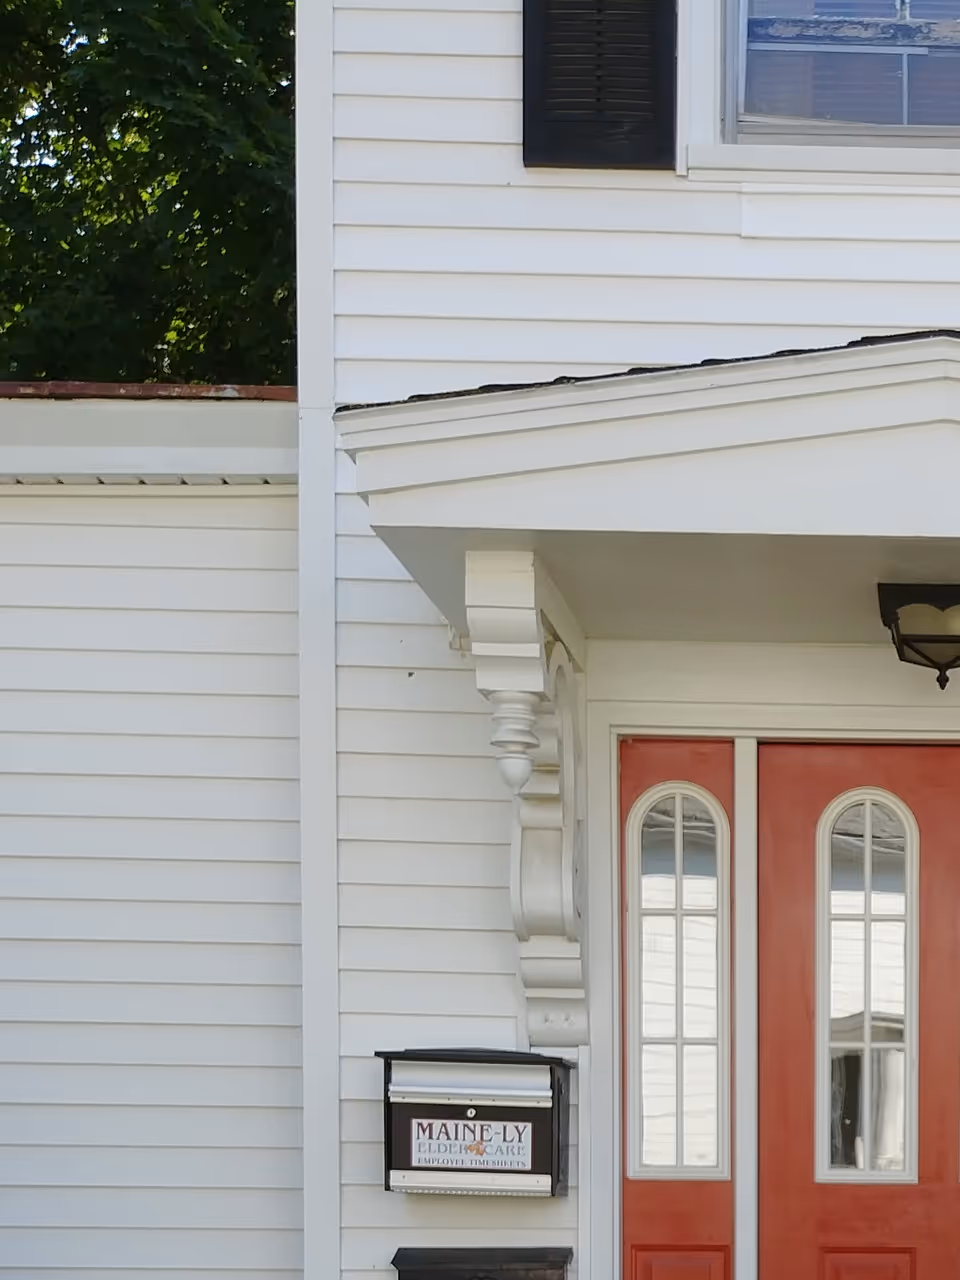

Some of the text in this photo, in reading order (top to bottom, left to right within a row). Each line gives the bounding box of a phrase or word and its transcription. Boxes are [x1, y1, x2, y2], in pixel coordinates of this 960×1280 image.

[416, 1121, 528, 1144] MAINE-LY
[417, 1141, 526, 1157] ELDER CARE
[417, 1157, 527, 1169] EMPLOYEE TIMESHEETS
